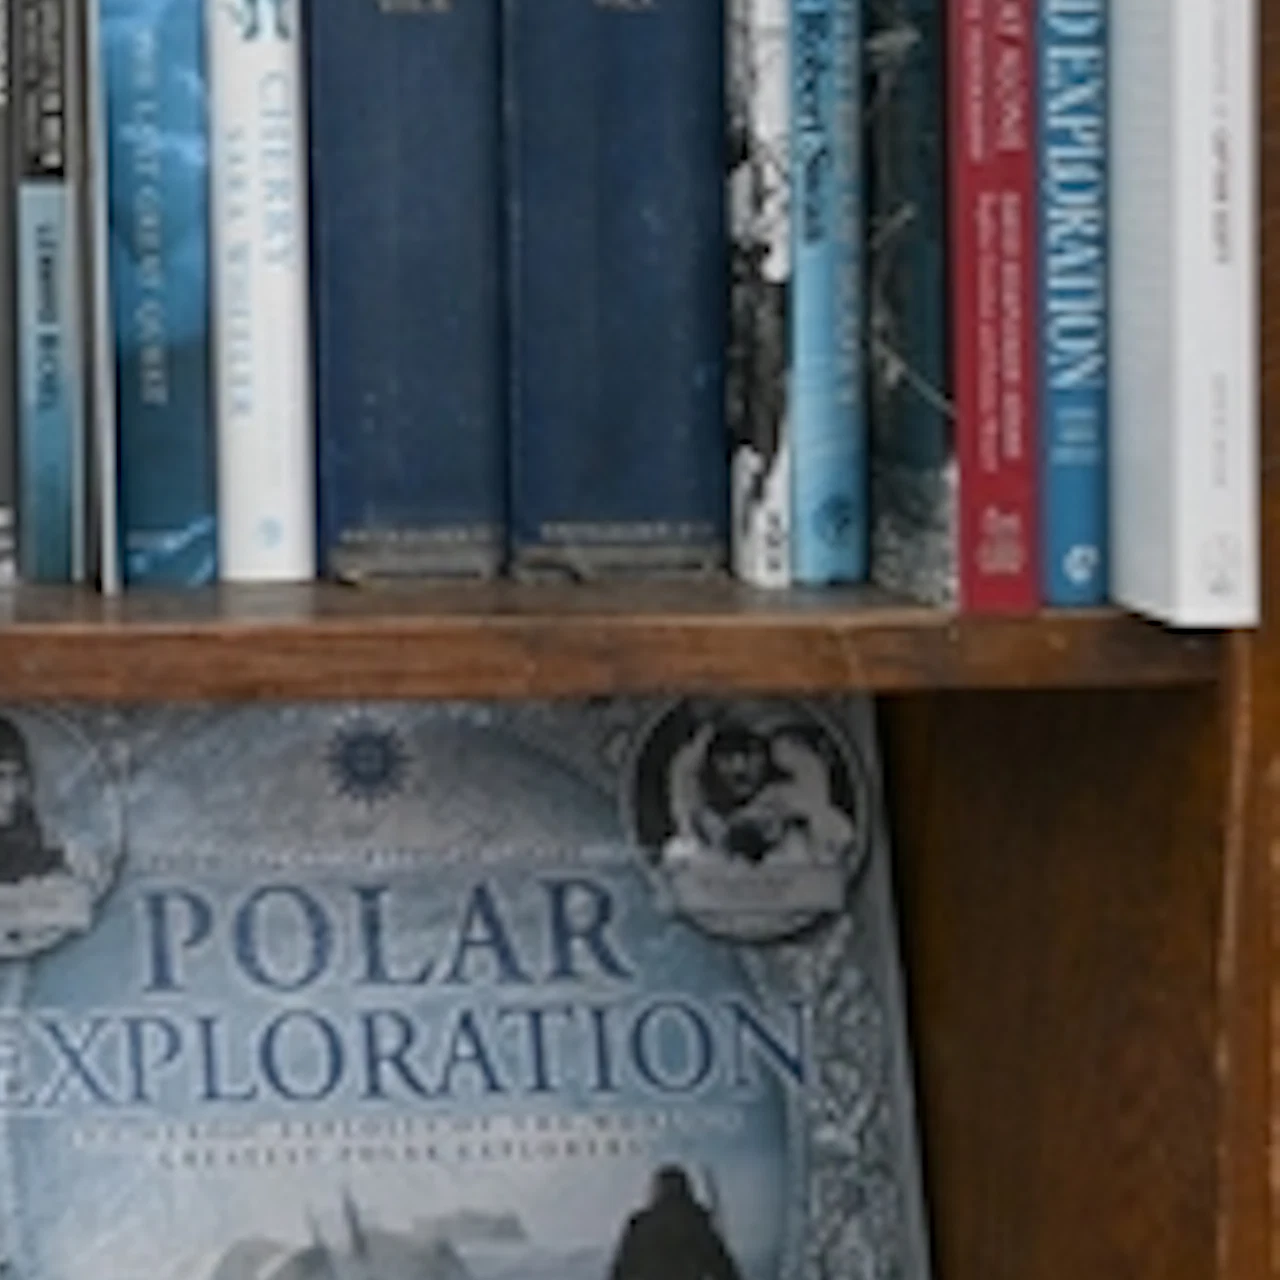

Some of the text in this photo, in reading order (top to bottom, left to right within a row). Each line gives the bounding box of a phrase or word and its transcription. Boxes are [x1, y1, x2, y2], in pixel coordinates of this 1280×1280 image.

[797, 11, 831, 134] Robert
[258, 71, 296, 274] CHERRY
[1044, 45, 1105, 389] EXPLORATION
[142, 874, 641, 994] POLAR
